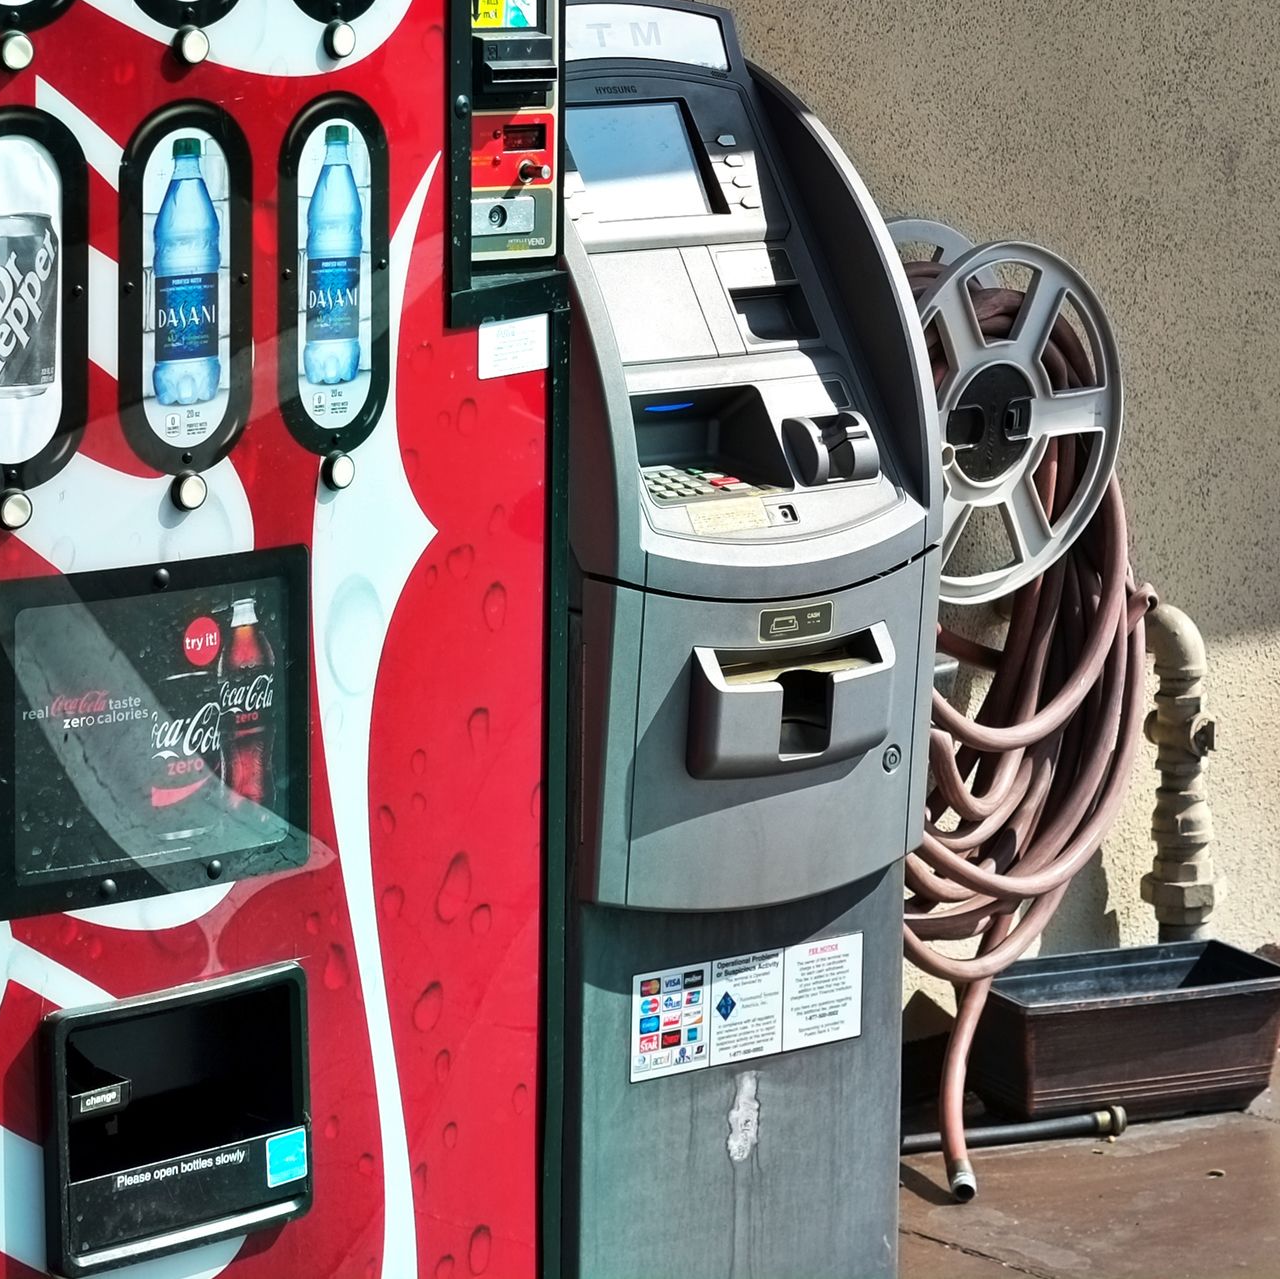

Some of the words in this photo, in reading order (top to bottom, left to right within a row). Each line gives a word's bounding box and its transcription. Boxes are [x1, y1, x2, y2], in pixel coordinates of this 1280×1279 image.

[567, 21, 663, 48] TM
[595, 85, 638, 95] HYOSUNG
[309, 286, 358, 311] DASANI
[158, 302, 216, 332] DASANI
[184, 634, 203, 652] try
[205, 633, 218, 647] it!
[22, 705, 49, 721] real
[109, 696, 141, 711] taste
[63, 715, 95, 729] zero
[97, 708, 149, 725] calories
[235, 711, 259, 725] zero
[167, 757, 205, 777] zero
[665, 978, 680, 988] VISA
[640, 1041, 658, 1053] STAR
[85, 1089, 117, 1107] change
[116, 1170, 151, 1188] Please
[153, 1164, 179, 1181] open
[180, 1157, 213, 1174] bottles
[215, 1148, 246, 1165] slowly
